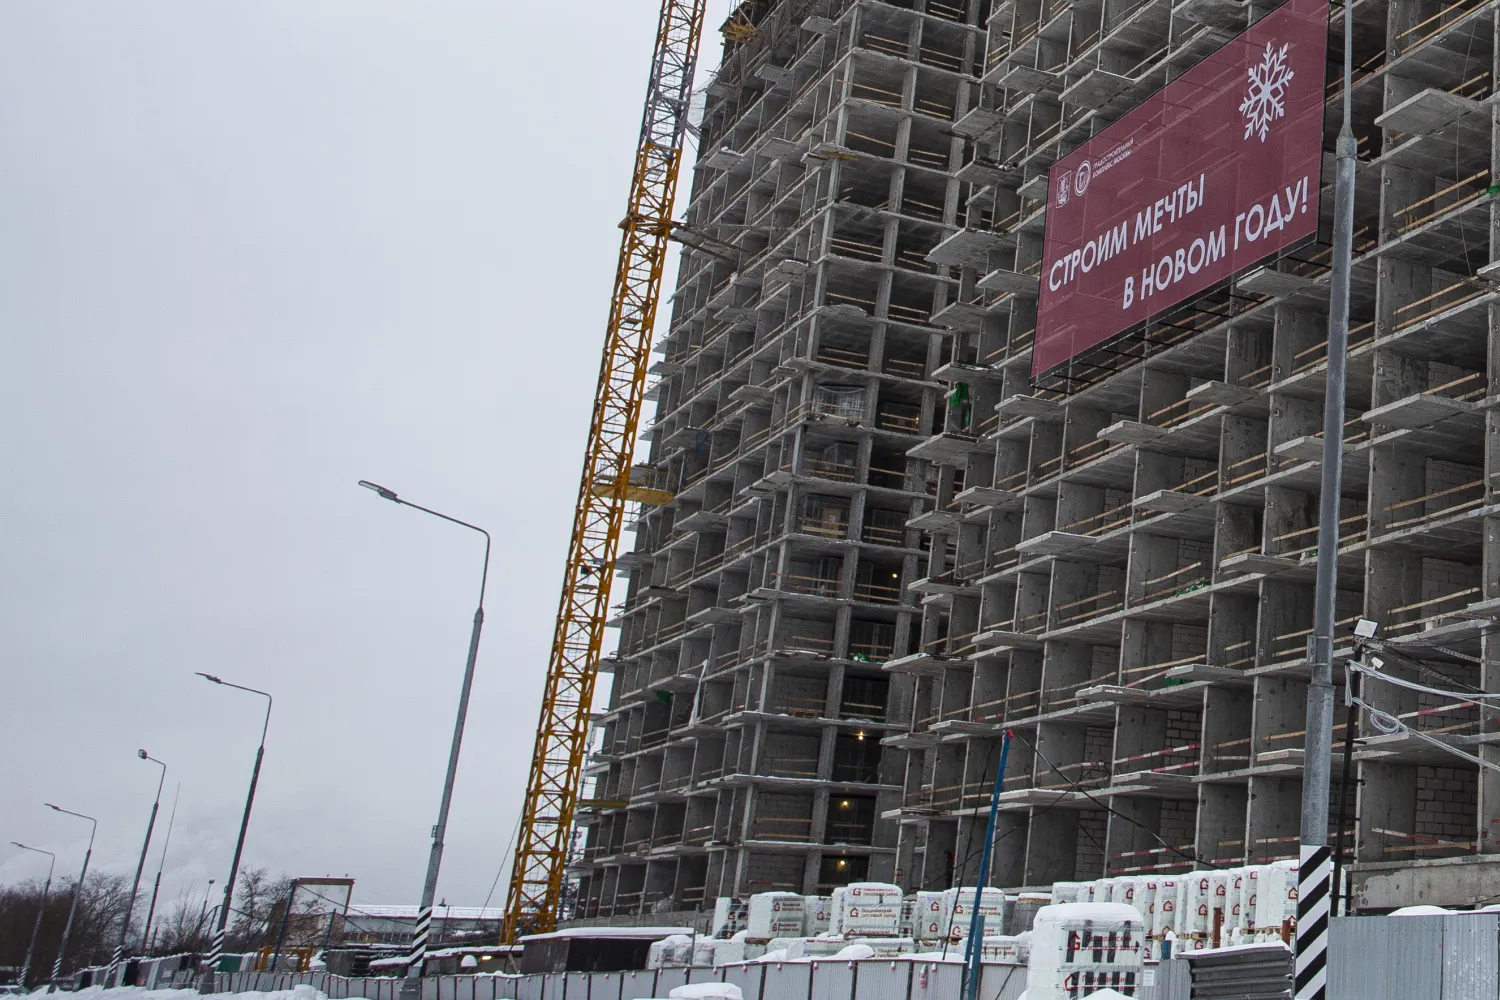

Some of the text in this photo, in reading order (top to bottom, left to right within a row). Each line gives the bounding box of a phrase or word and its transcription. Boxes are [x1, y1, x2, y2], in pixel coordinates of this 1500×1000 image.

[1049, 173, 1205, 292] СТРОИМ МЕЧТЫ
[1122, 175, 1309, 311] В НОВОМ ГОДУ!
